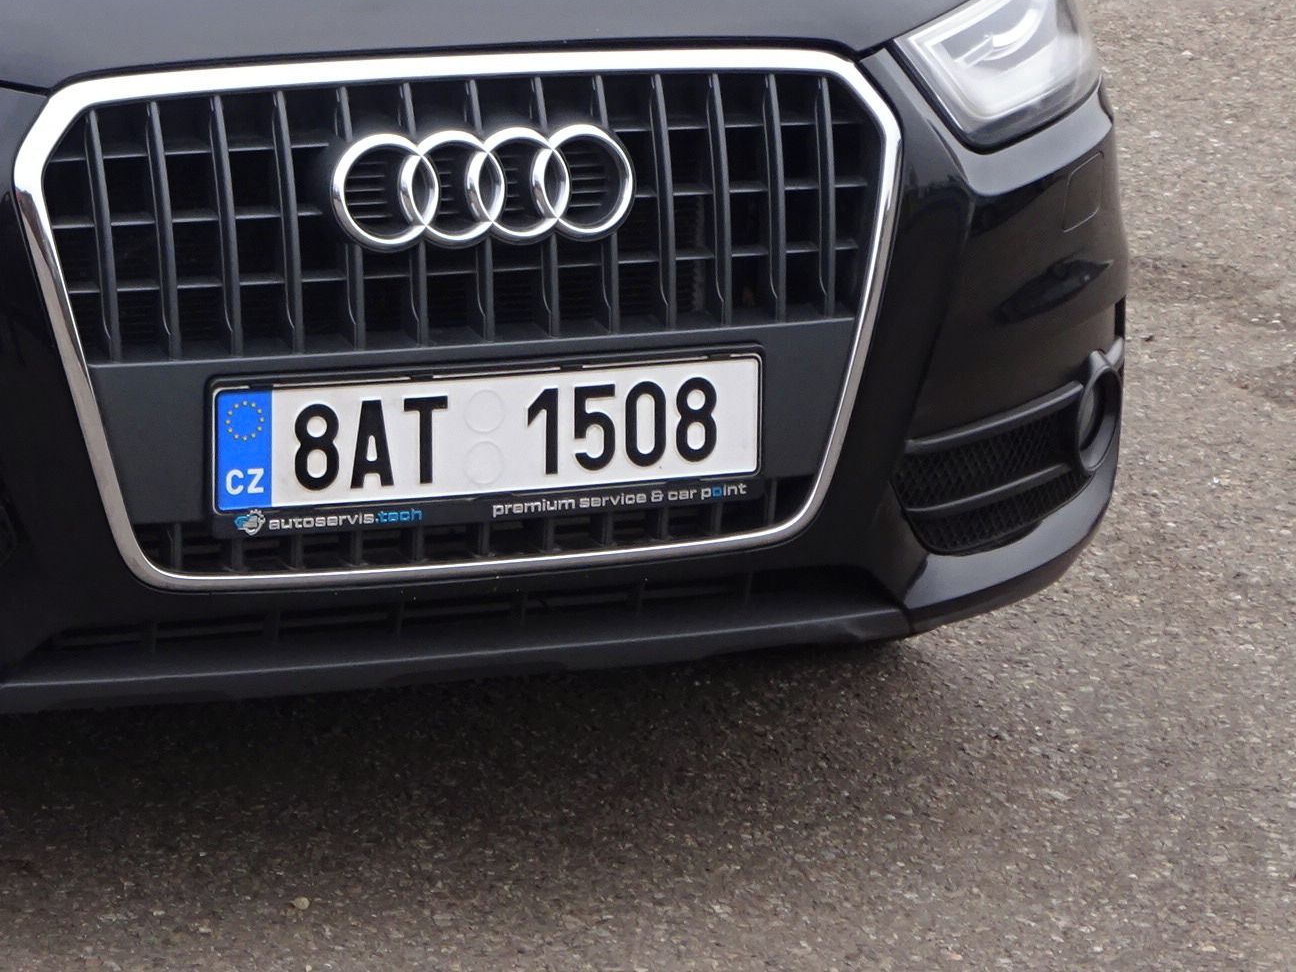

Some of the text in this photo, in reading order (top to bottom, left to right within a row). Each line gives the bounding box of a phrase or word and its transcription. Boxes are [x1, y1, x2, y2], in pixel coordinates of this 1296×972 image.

[293, 376, 718, 492] 8AT 1508
[225, 468, 264, 496] CZ
[492, 482, 747, 518] premium service & car point
[268, 507, 423, 530] autoservis.tech
